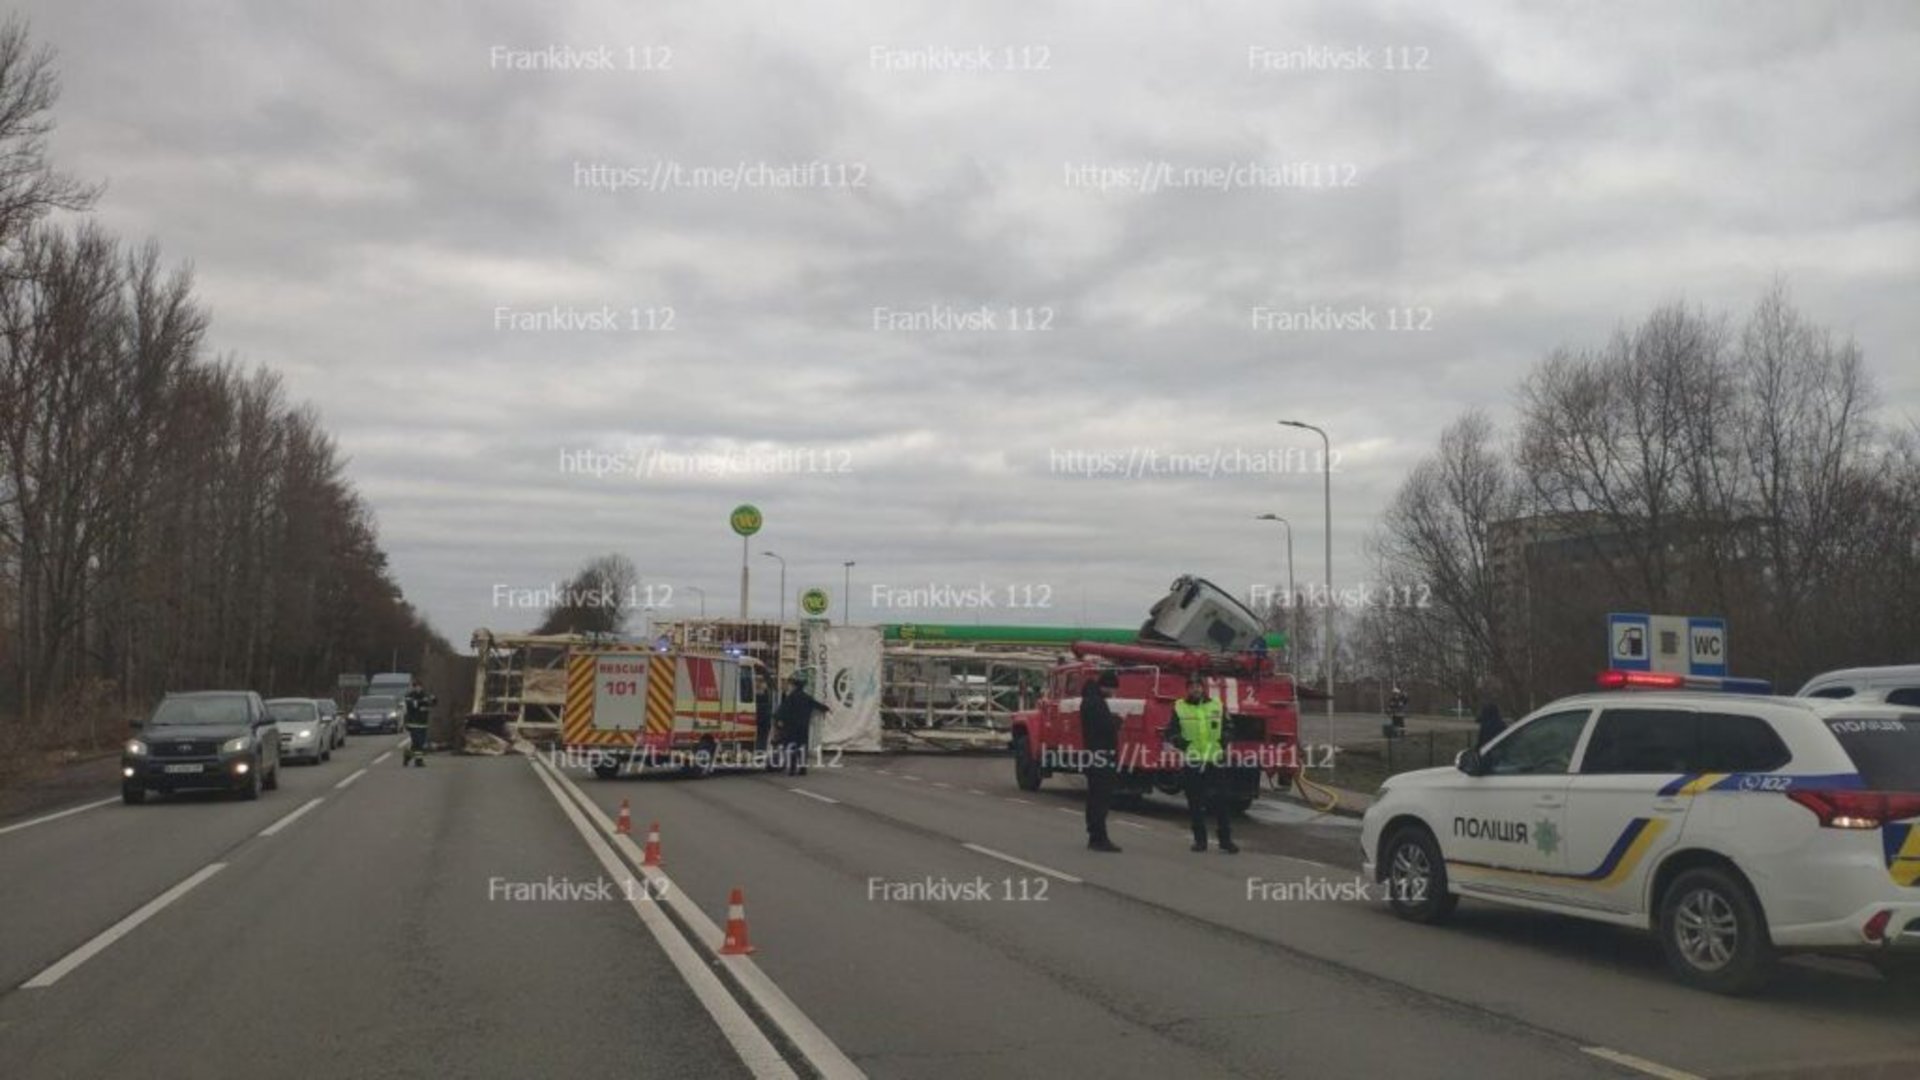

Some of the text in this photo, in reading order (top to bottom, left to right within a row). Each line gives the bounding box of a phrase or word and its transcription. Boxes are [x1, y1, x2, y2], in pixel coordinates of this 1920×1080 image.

[1694, 635, 1721, 656] WC
[600, 663, 645, 675] RESCUE
[605, 680, 637, 696] 101
[1759, 777, 1792, 791] 102
[1454, 817, 1528, 844] ПОЛІЦІЯ
